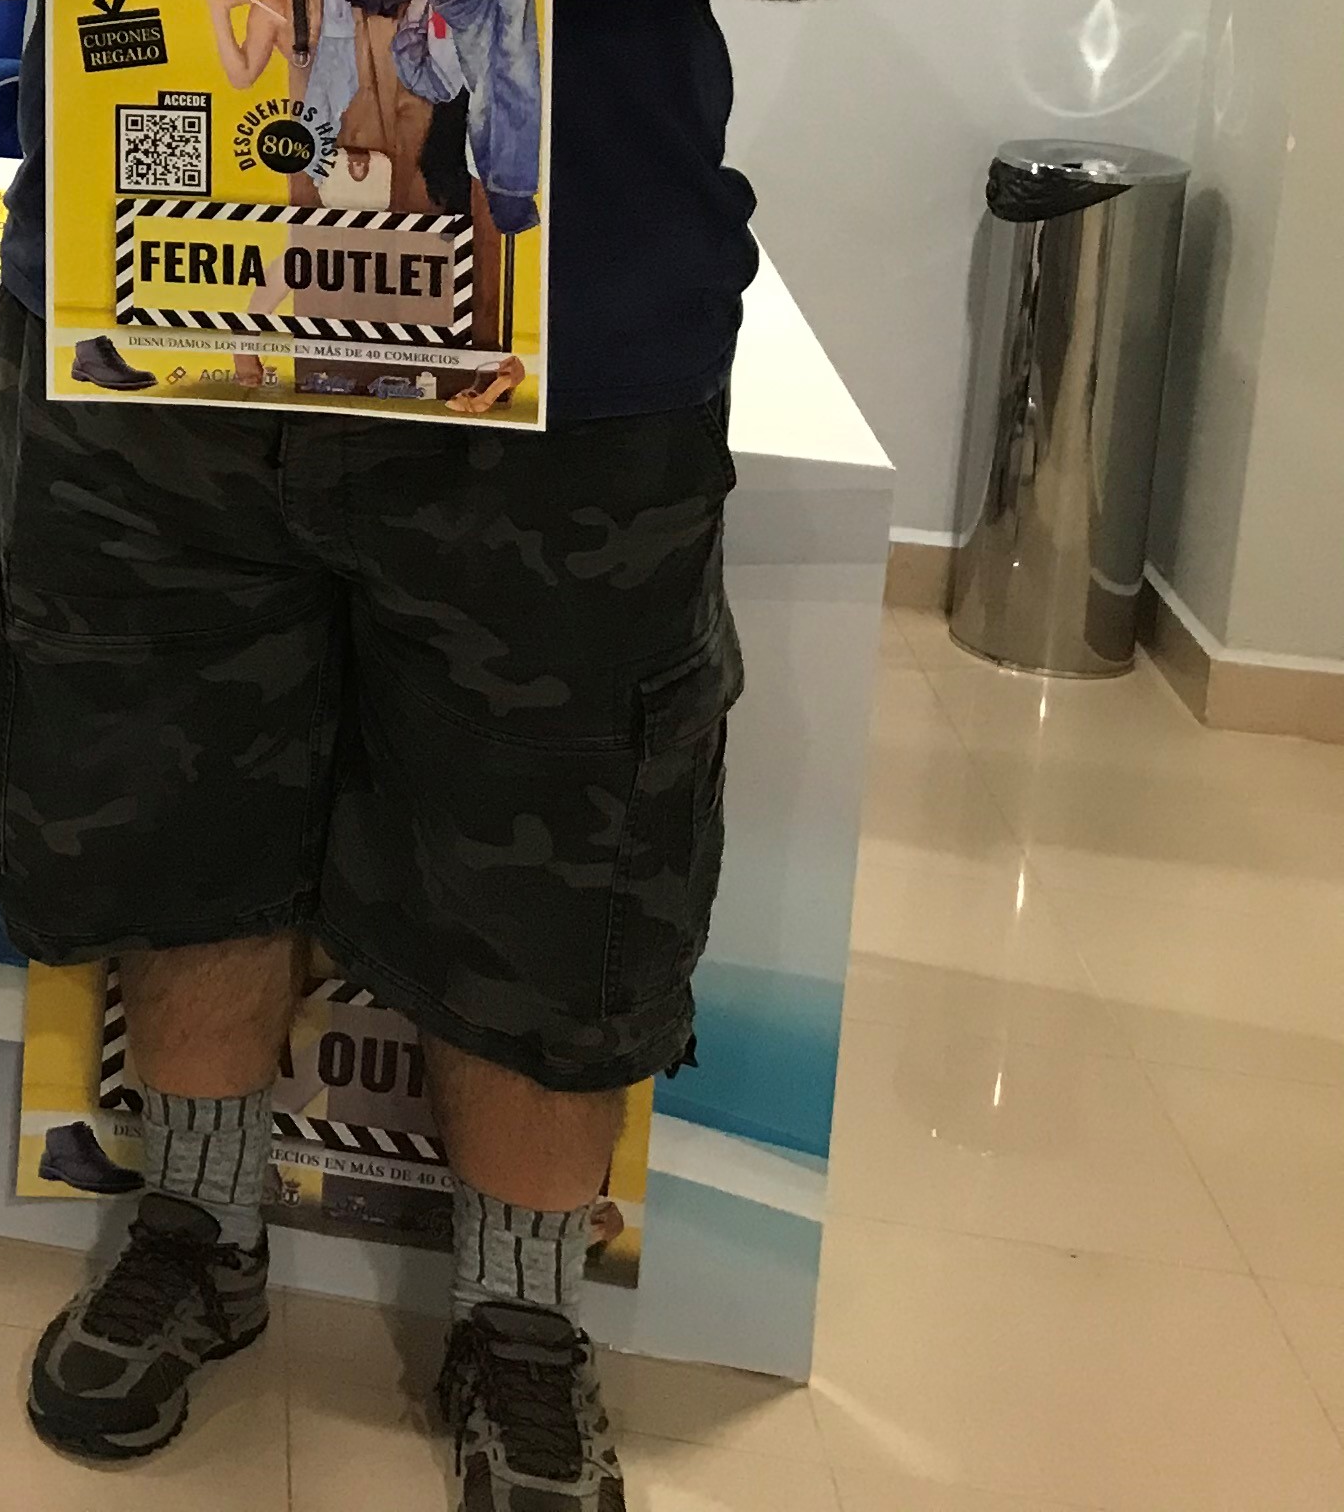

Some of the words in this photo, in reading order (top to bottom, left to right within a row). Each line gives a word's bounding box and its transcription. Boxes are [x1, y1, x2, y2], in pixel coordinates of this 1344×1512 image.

[83, 27, 160, 49] CUPONES
[90, 45, 159, 67] REGALO
[164, 94, 206, 107] ACCEDE
[232, 99, 318, 171] DESCUENTOS
[313, 121, 340, 178] HASTA
[262, 135, 310, 160] 80%
[140, 241, 266, 287] FERIA
[285, 247, 448, 298] OUTLET
[129, 335, 211, 350] DESNUDAMOS
[214, 340, 236, 351] LOS
[240, 340, 291, 354] PRECIOS
[294, 344, 310, 354] EN
[314, 343, 341, 357] MÁS
[345, 348, 362, 358] DE
[366, 349, 380, 360] 40
[384, 351, 459, 365] COMERCIOS
[319, 1031, 424, 1097] OUT
[325, 1158, 344, 1170] EN
[351, 1159, 384, 1177] MÁS
[391, 1169, 410, 1181] DE
[417, 1173, 434, 1184] 40
